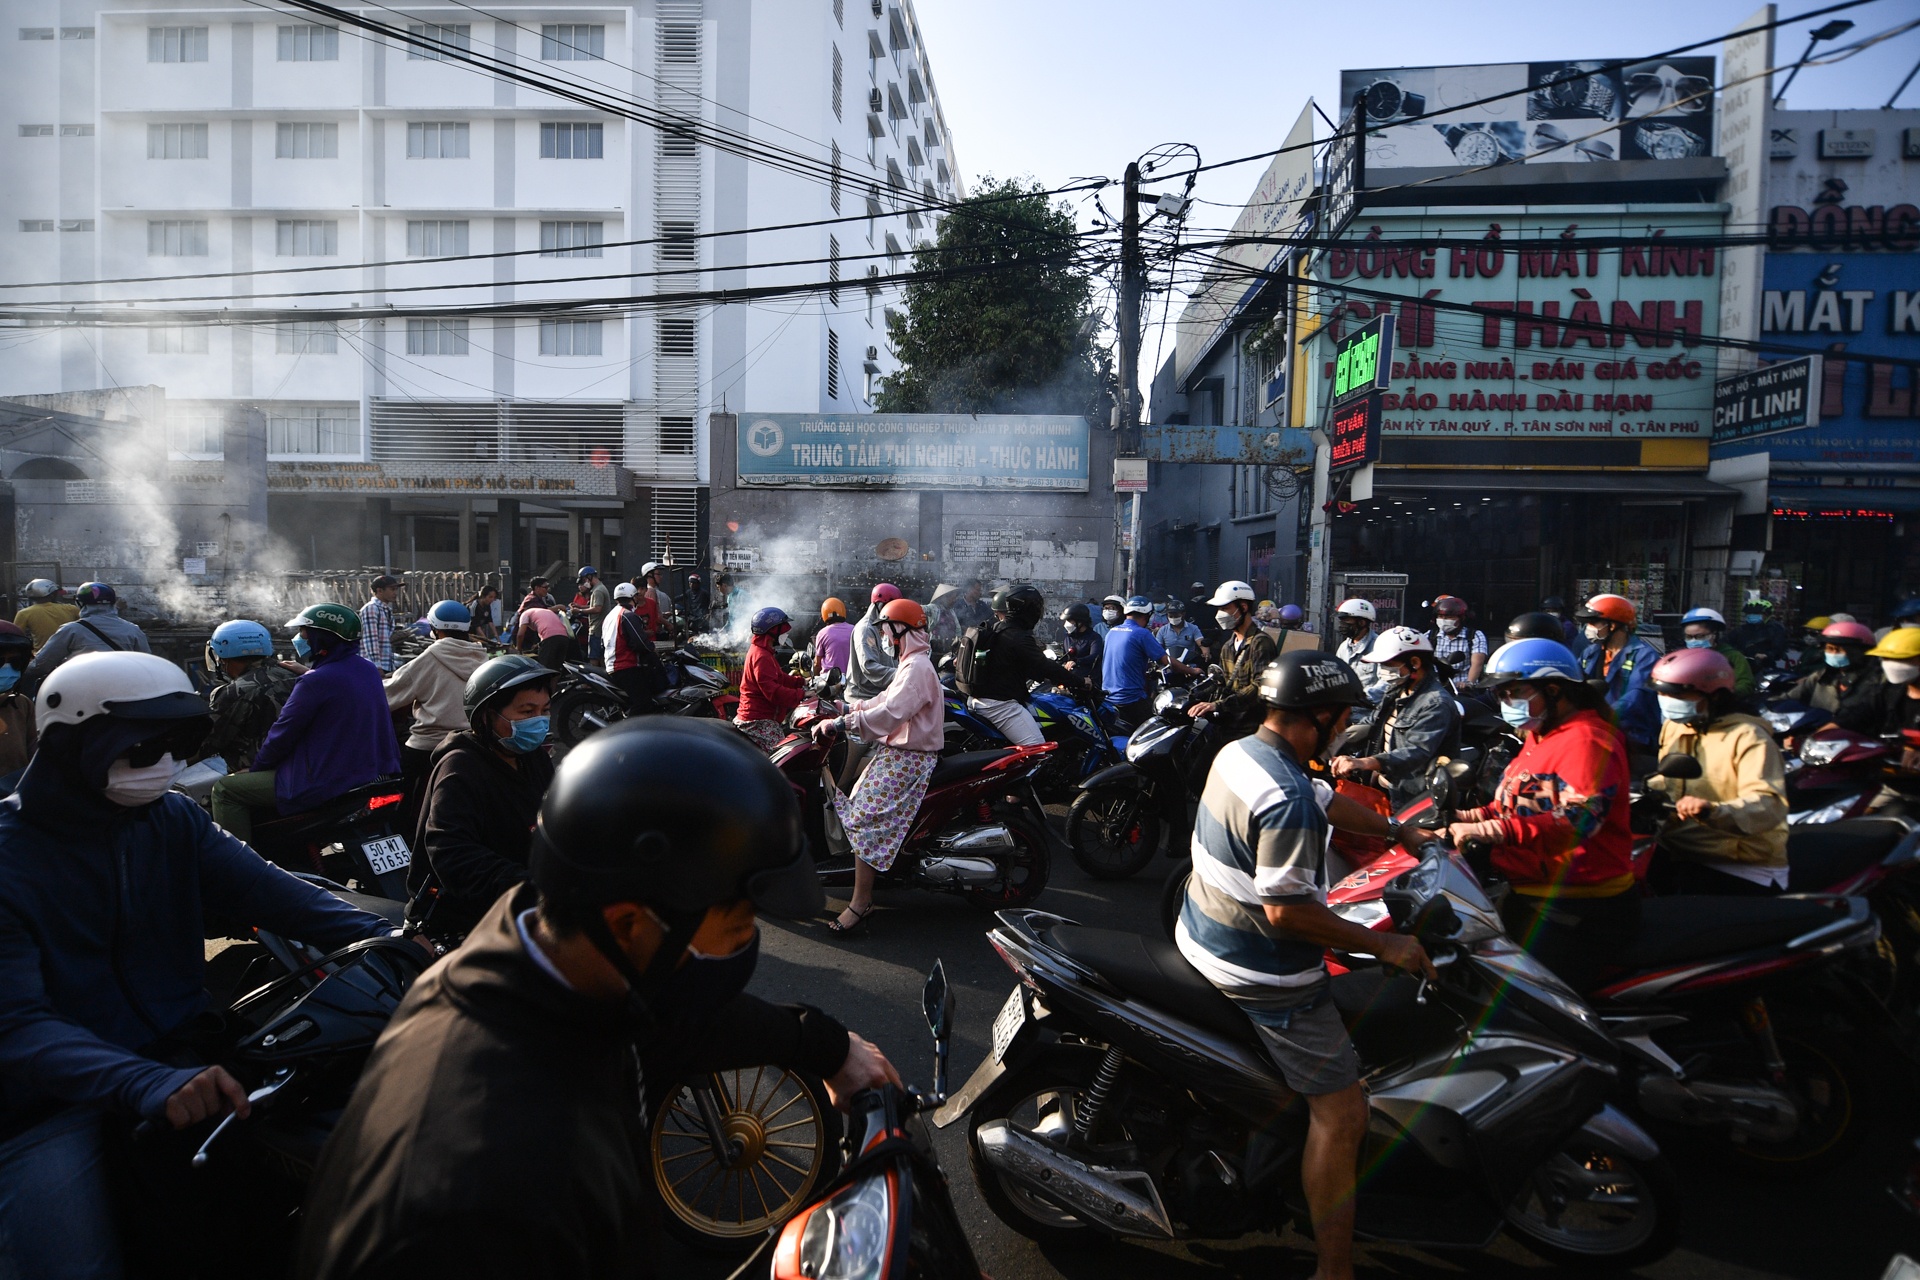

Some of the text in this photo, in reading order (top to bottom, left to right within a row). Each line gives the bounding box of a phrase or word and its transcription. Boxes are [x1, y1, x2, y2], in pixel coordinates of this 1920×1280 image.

[1828, 141, 1870, 149] CITIZEN
[1768, 178, 1920, 251] ĐỒNG
[1329, 225, 1436, 278] ĐỒNG
[1450, 223, 1504, 278] HỒ
[1518, 224, 1599, 278] MẮT
[1620, 229, 1715, 277] KÍNH
[1762, 263, 1875, 333] MẮT
[1474, 288, 1704, 347] THÀNH
[1465, 356, 1514, 380] NHÀ
[1532, 356, 1585, 380] BÁN
[1595, 355, 1637, 380] GIÁ
[1648, 352, 1702, 380] GỐC
[1757, 372, 1780, 388] MẮT
[1782, 364, 1806, 382] KÍNH
[1382, 387, 1653, 416] BẢO HÀNH DÀI HẠN
[1714, 388, 1802, 428] CHÍ LINH
[800, 419, 836, 433] TRƯỜNG
[839, 421, 854, 436] ĐẠI
[857, 421, 876, 436] HỌC
[1030, 421, 1046, 435] CHÍ
[1048, 424, 1071, 435] MINH
[1336, 409, 1364, 436] TƯ VẤN
[1405, 419, 1426, 432] KỲ
[1429, 418, 1459, 432] TÂN
[1461, 418, 1492, 433] QUÝ
[1523, 418, 1551, 432] TÂN
[1555, 418, 1587, 432] SƠN
[1638, 418, 1667, 432] TÂN
[1670, 418, 1700, 432] PHÚ
[791, 443, 843, 467] TRUNG
[848, 438, 880, 467] TÂM
[885, 437, 910, 467] THÍ
[915, 440, 976, 471] NGHIỆM
[989, 441, 1031, 474] THỰC
[1036, 440, 1079, 470] HÀNH
[1332, 432, 1366, 460] MIỄN PHÍ
[315, 610, 345, 624] Grab
[368, 838, 400, 857] 50-N1
[371, 850, 411, 872] 516.55
